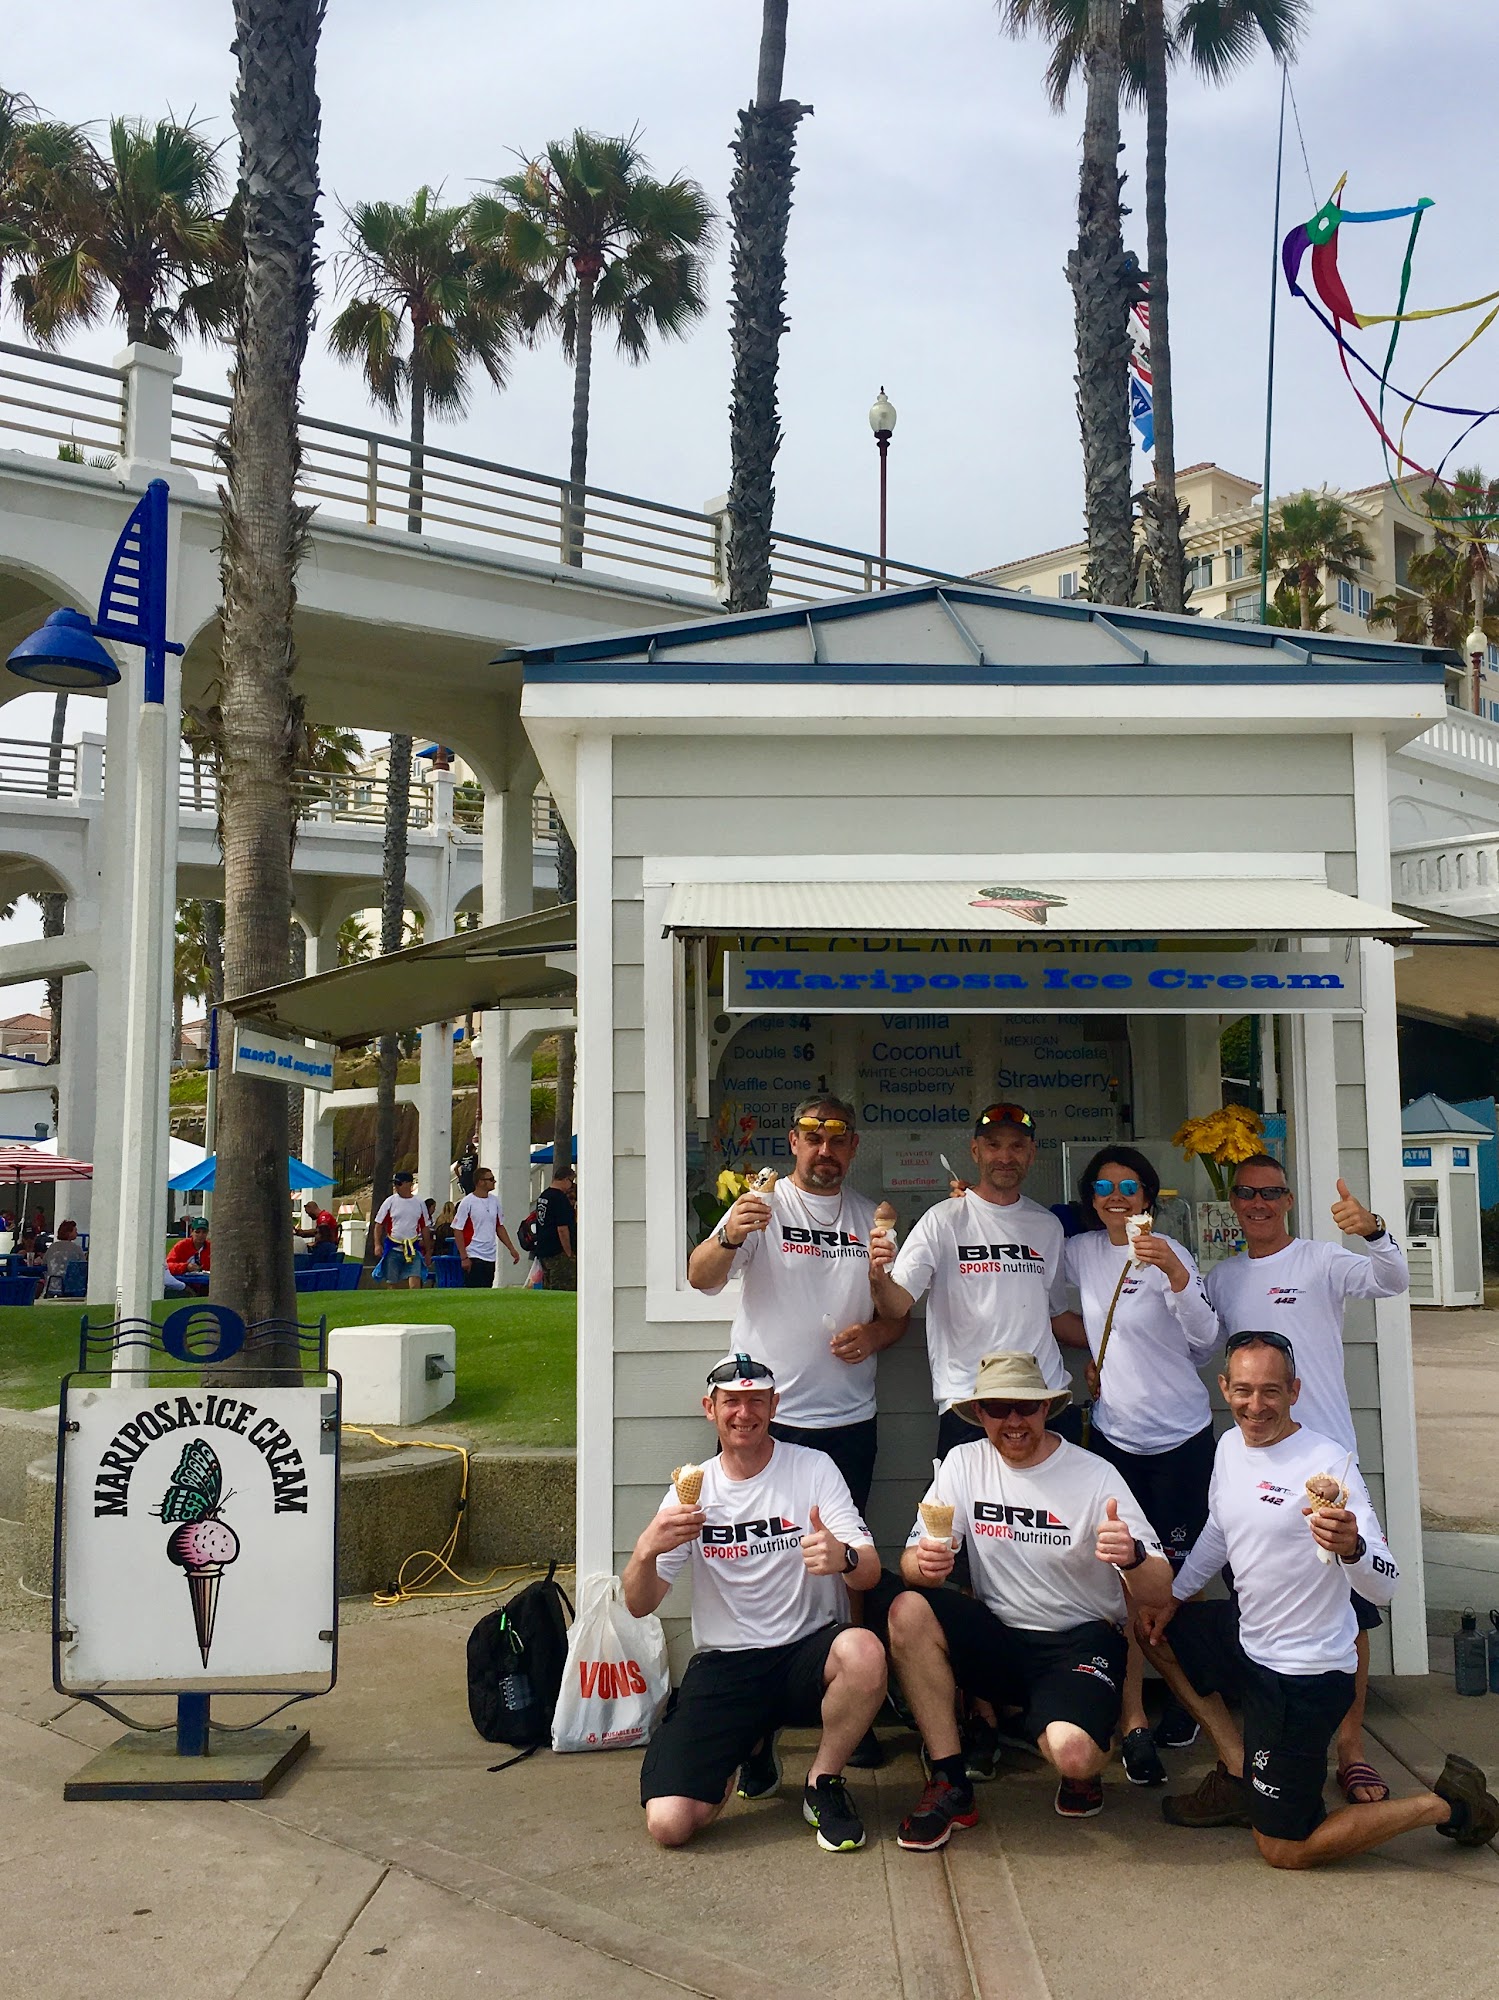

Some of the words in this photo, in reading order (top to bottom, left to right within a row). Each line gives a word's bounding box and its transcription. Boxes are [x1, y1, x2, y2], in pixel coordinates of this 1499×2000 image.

[745, 968, 1029, 994] Mariposa
[1043, 968, 1133, 990] Ice
[1148, 968, 1345, 990] Cream
[743, 1014, 785, 1031] ingle
[881, 1014, 950, 1030] Vanilla
[1004, 1036, 1058, 1046] MEXICAN
[734, 1045, 786, 1060] Double
[792, 1042, 815, 1061] $6
[872, 1041, 962, 1061] Coconut
[1034, 1046, 1108, 1060] Chocolate
[859, 1068, 897, 1078] WHITE
[899, 1066, 975, 1077] CHOCOLATE
[998, 1069, 1110, 1092] Strawberry
[723, 1076, 768, 1091] Waffle
[773, 1076, 811, 1090] Cone
[817, 1074, 829, 1093] 1
[879, 1079, 955, 1096] Raspberry
[743, 1102, 777, 1113] ROOT
[863, 1103, 971, 1123] Chocolate
[1064, 1104, 1114, 1118] Cream
[720, 1137, 792, 1157] WATE
[1404, 1149, 1429, 1160] ATM
[891, 1177, 940, 1187] Butterfinger
[782, 1226, 867, 1248] BRL
[782, 1242, 821, 1257] SPORTS
[958, 1244, 1045, 1262] BRL
[960, 1261, 1001, 1274] SPORTS
[1274, 1297, 1297, 1305] 442
[94, 1396, 199, 1518] MARIPOSA
[198, 1394, 257, 1436] ICE
[247, 1416, 308, 1514] CREAM
[1260, 1495, 1285, 1506] 442
[974, 1501, 1071, 1531] BRL
[702, 1516, 803, 1544] BRL
[975, 1522, 1013, 1540] SPORTS
[1013, 1531, 1072, 1546] nutrition
[703, 1544, 749, 1559] SPORTS
[1372, 1554, 1400, 1579] BR
[579, 1660, 648, 1700] VONS
